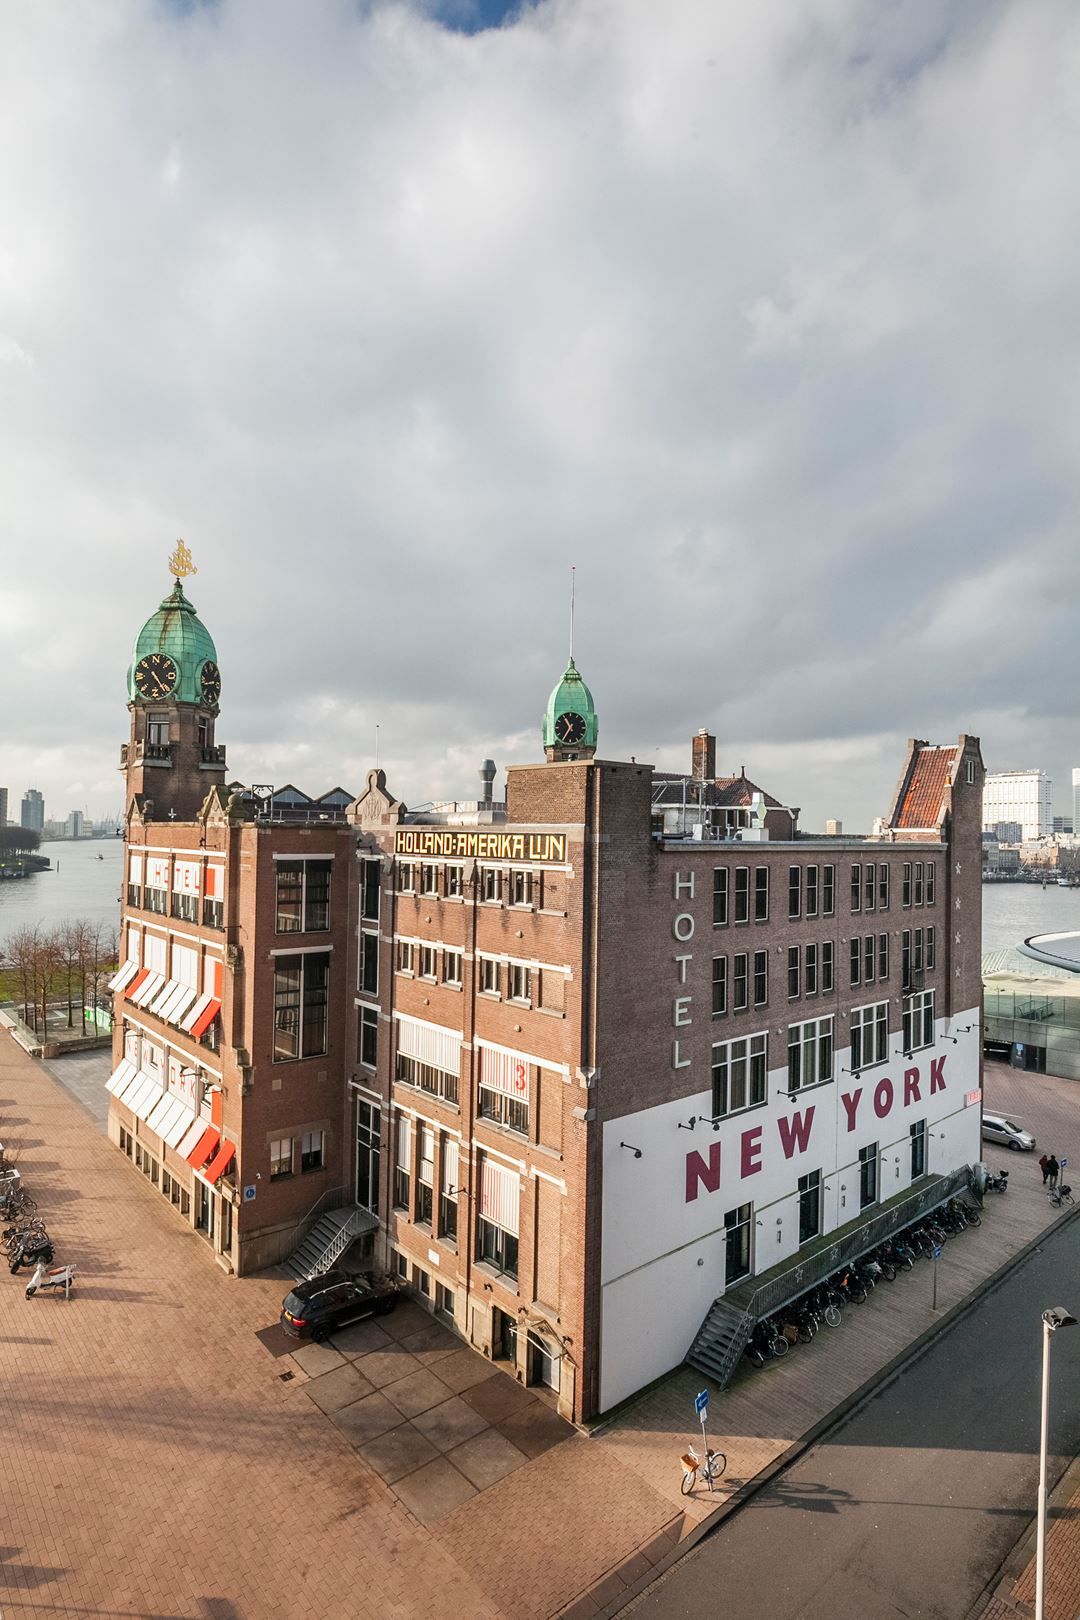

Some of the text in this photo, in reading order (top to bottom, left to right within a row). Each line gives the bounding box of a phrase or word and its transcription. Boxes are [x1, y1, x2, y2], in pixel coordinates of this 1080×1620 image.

[529, 834, 564, 861] LIJN
[674, 871, 695, 1069] HOTEL
[515, 1064, 525, 1091] 3
[685, 1055, 947, 1203] NEW YORK
